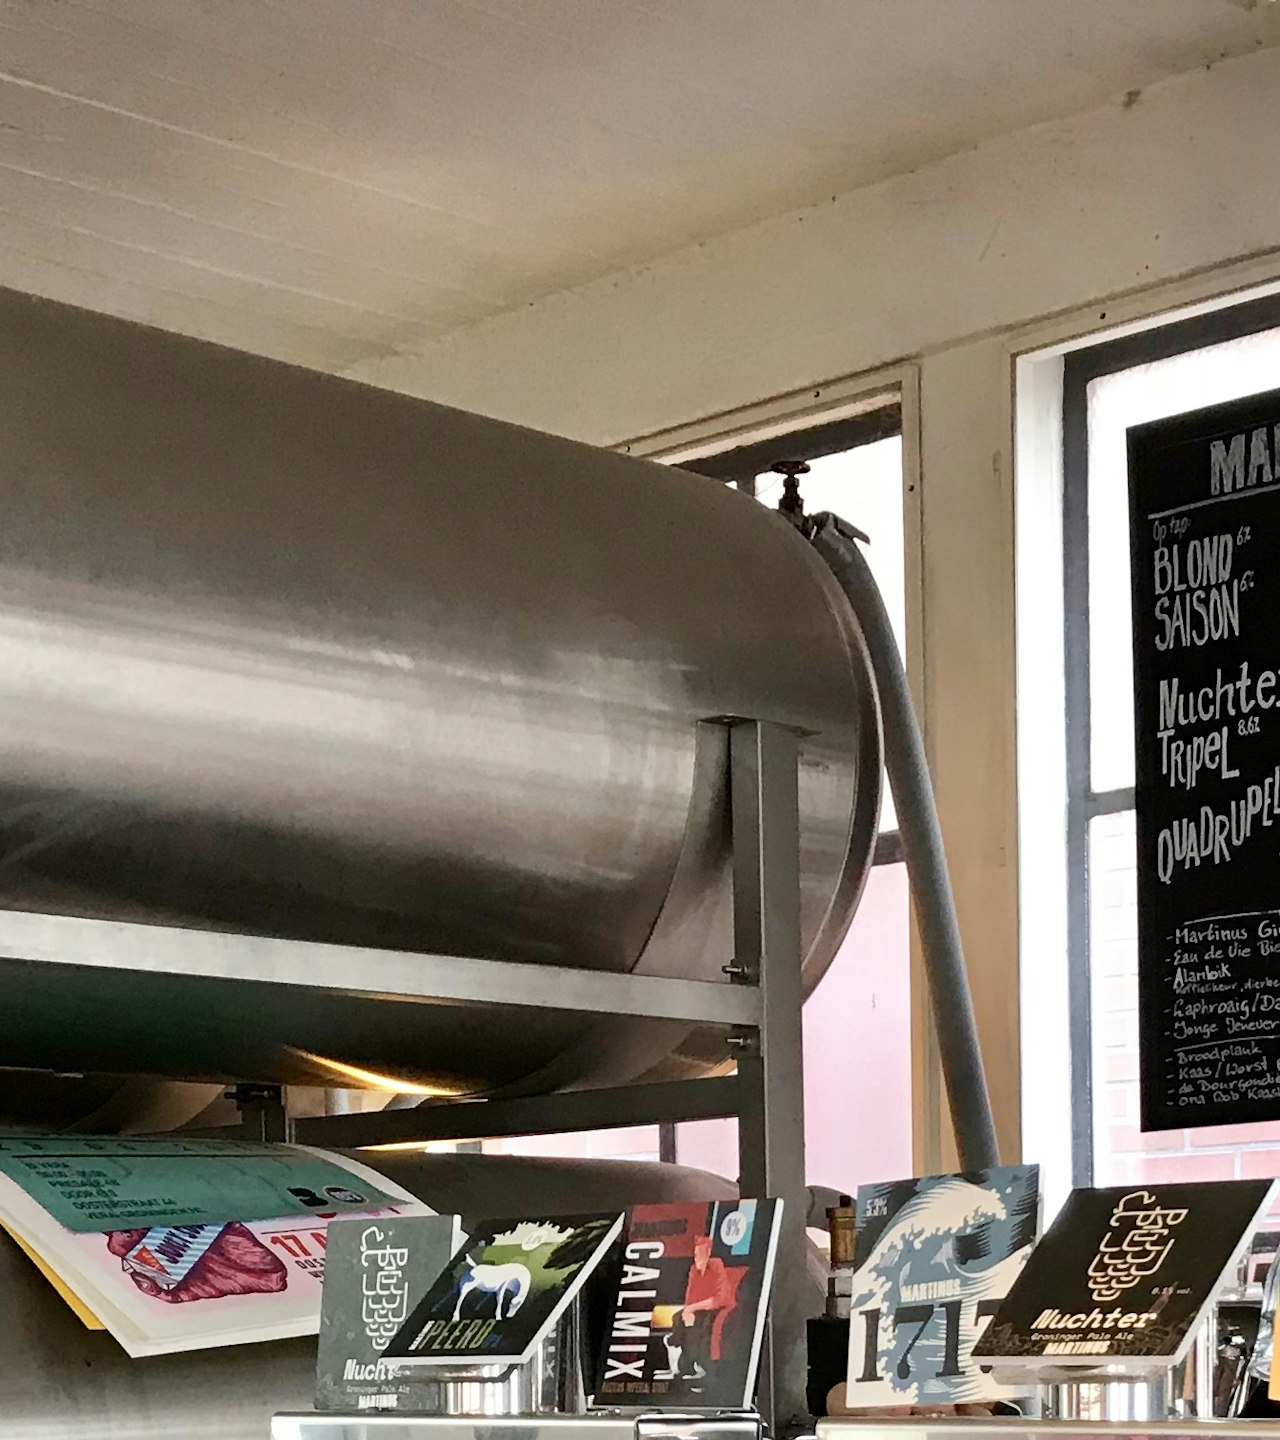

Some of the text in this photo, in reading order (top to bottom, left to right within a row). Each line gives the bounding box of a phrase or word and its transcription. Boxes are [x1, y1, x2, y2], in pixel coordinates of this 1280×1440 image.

[1154, 534, 1233, 594] BLOND
[1155, 579, 1239, 650] SAISON
[1176, 923, 1247, 944] Martinus
[1174, 950, 1198, 965] Eau
[1204, 945, 1224, 959] de
[1228, 942, 1251, 958] Vie
[1174, 1021, 1218, 1039] Jonge
[1179, 1067, 1212, 1080] Kaas
[1226, 1056, 1267, 1076] Worst
[272, 1235, 312, 1257] 17
[900, 1279, 961, 1303] MARTINUS
[604, 1241, 665, 1380] CALMIX
[1030, 1308, 1157, 1330] Nuchter
[1031, 1332, 1134, 1342] Groninger Pale Ale
[1043, 1341, 1111, 1356] MARTINUS
